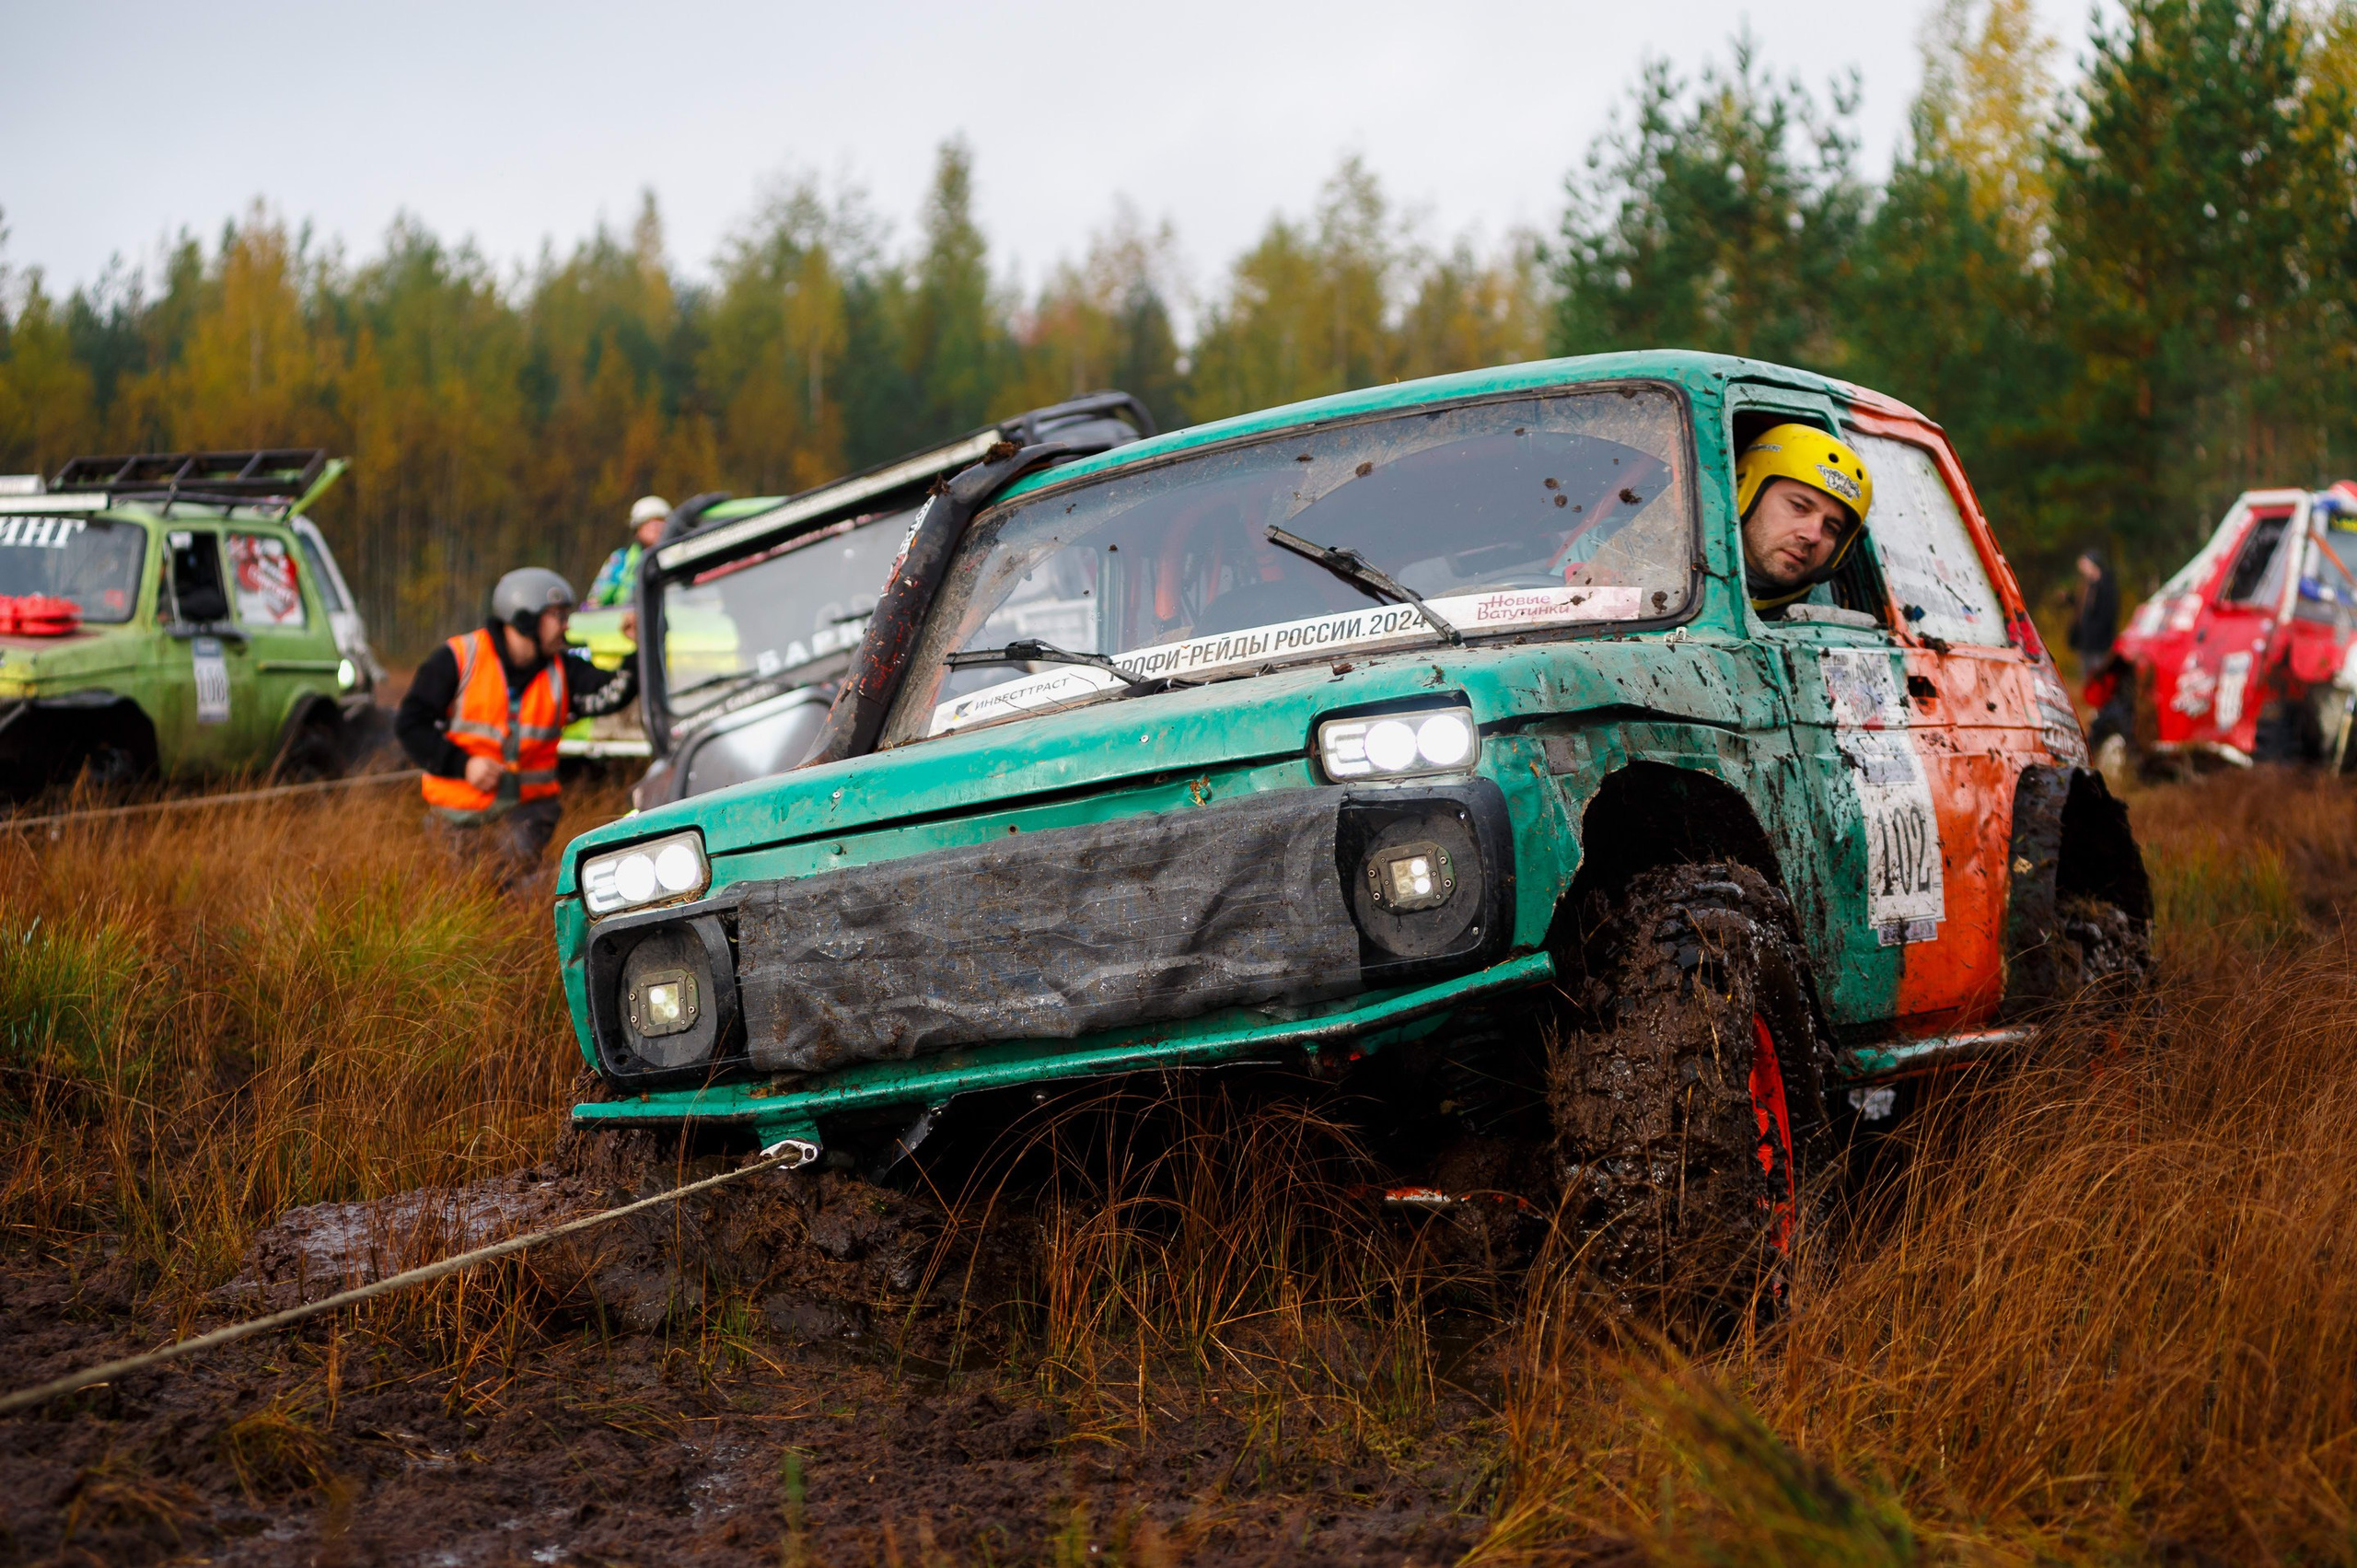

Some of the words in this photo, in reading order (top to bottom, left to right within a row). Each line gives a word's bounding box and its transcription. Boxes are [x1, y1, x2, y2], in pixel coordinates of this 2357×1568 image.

[1477, 602, 1570, 621] Ватутинки
[1478, 595, 1550, 609] Новые
[1274, 610, 1428, 651] РОССИИ.2024
[974, 678, 1071, 711] ИНВЕСТТРАСТ
[1876, 807, 1931, 897] 102
